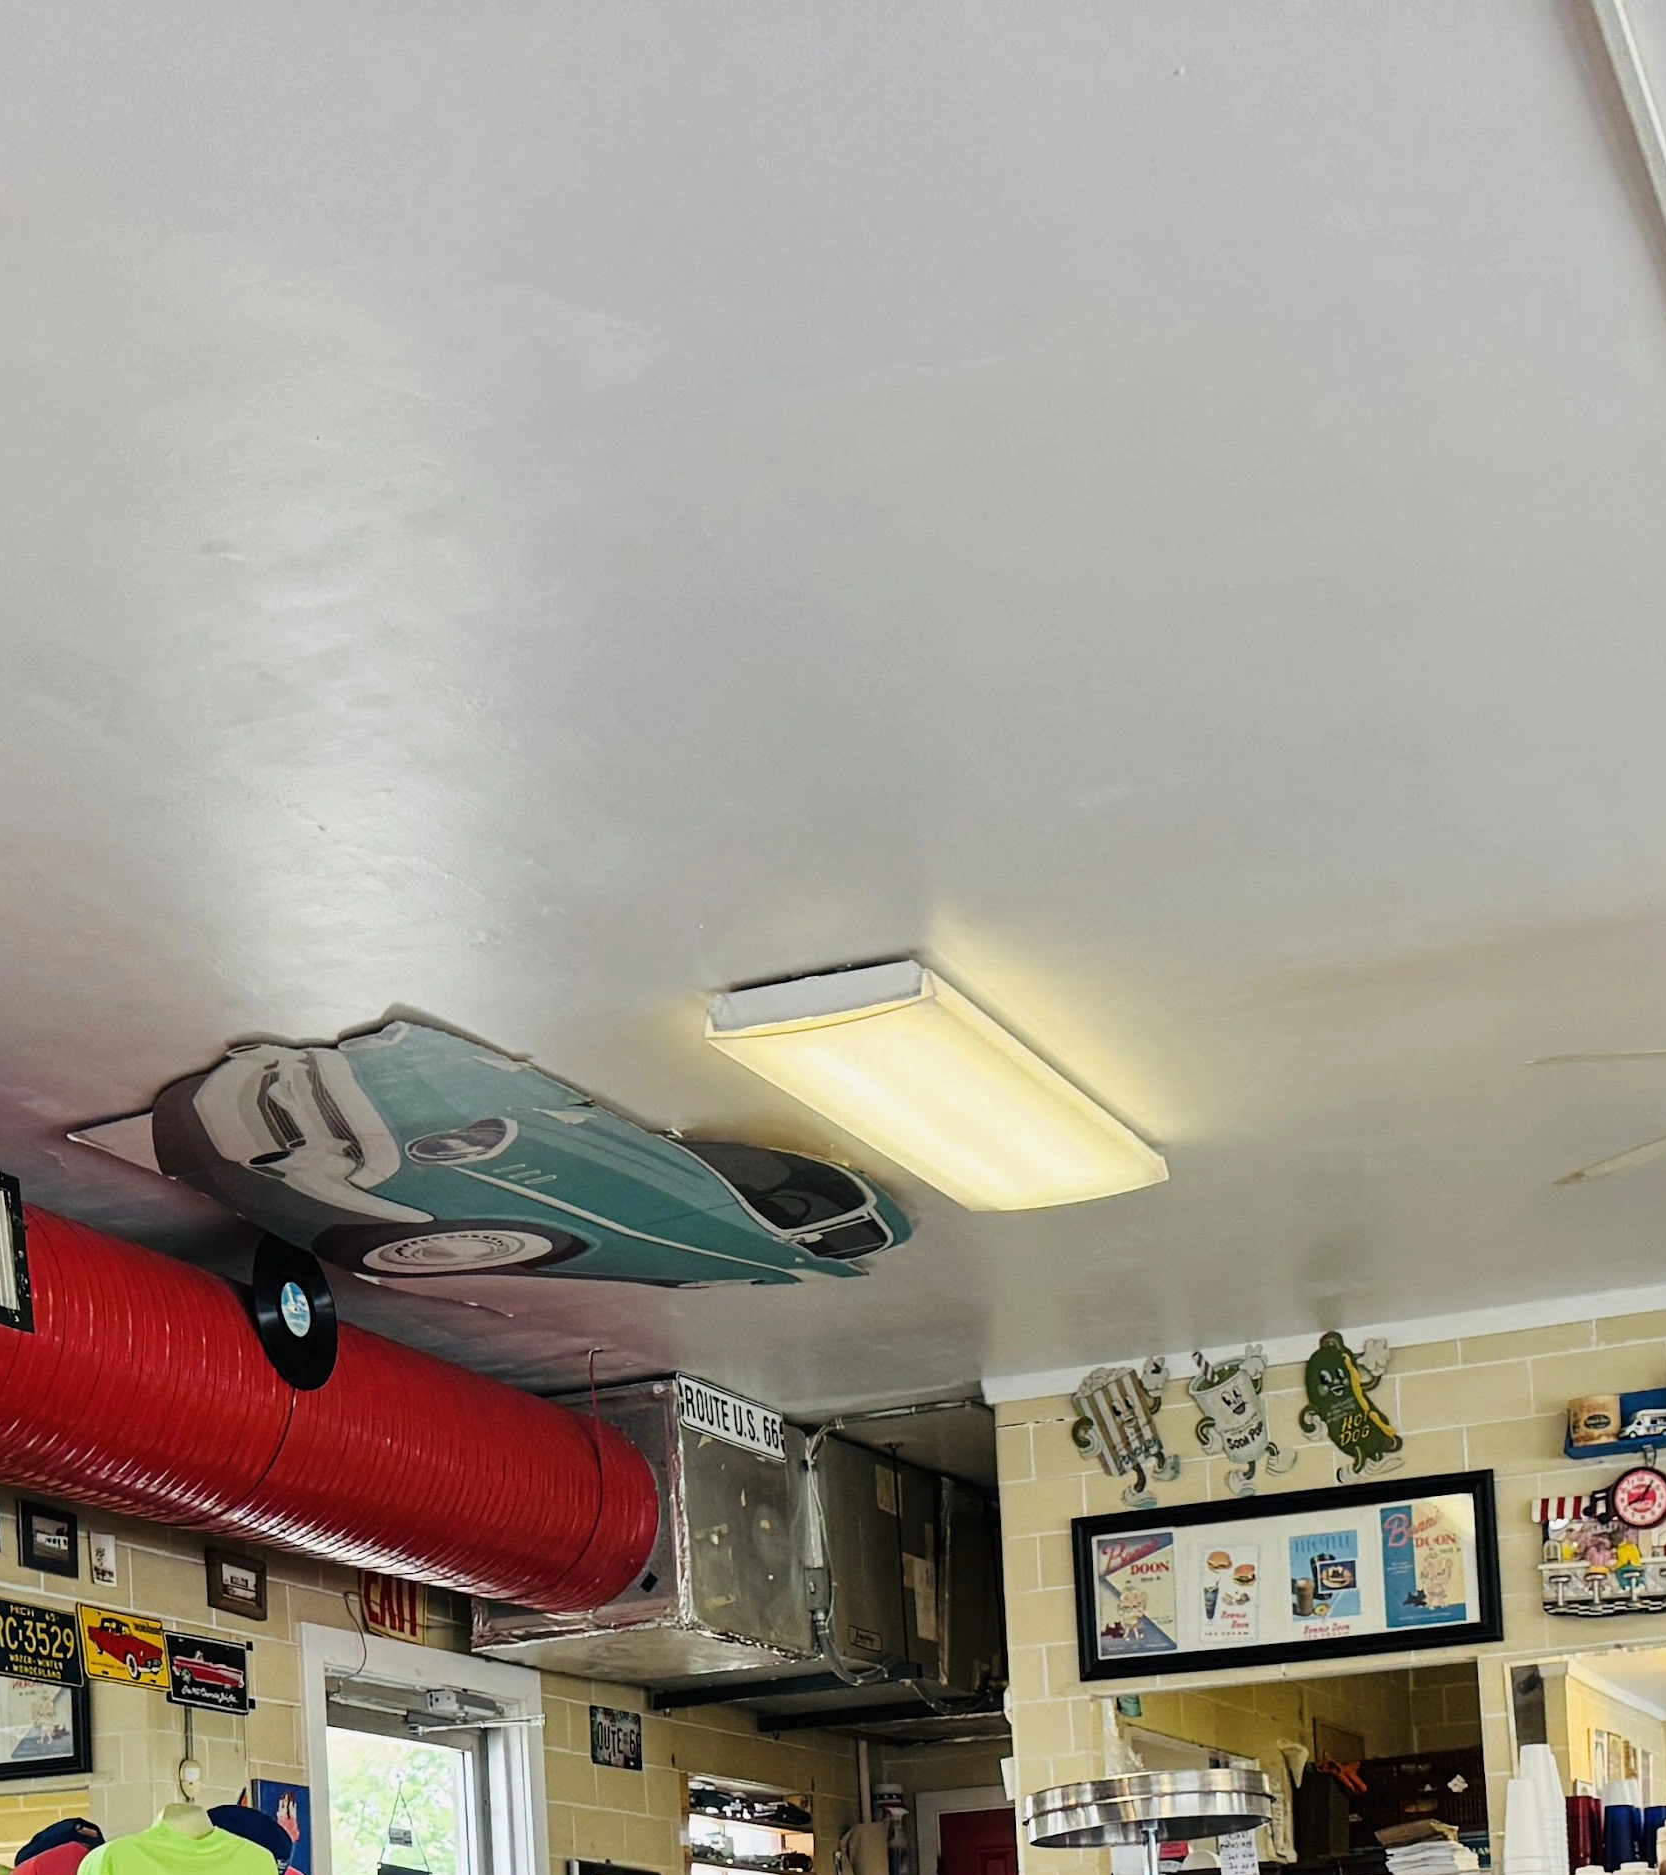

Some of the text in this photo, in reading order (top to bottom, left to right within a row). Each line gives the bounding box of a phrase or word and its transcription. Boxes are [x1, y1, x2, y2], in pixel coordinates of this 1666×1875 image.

[684, 1383, 780, 1450] ROUTE U.S. 66
[1339, 1423, 1370, 1448] DOG
